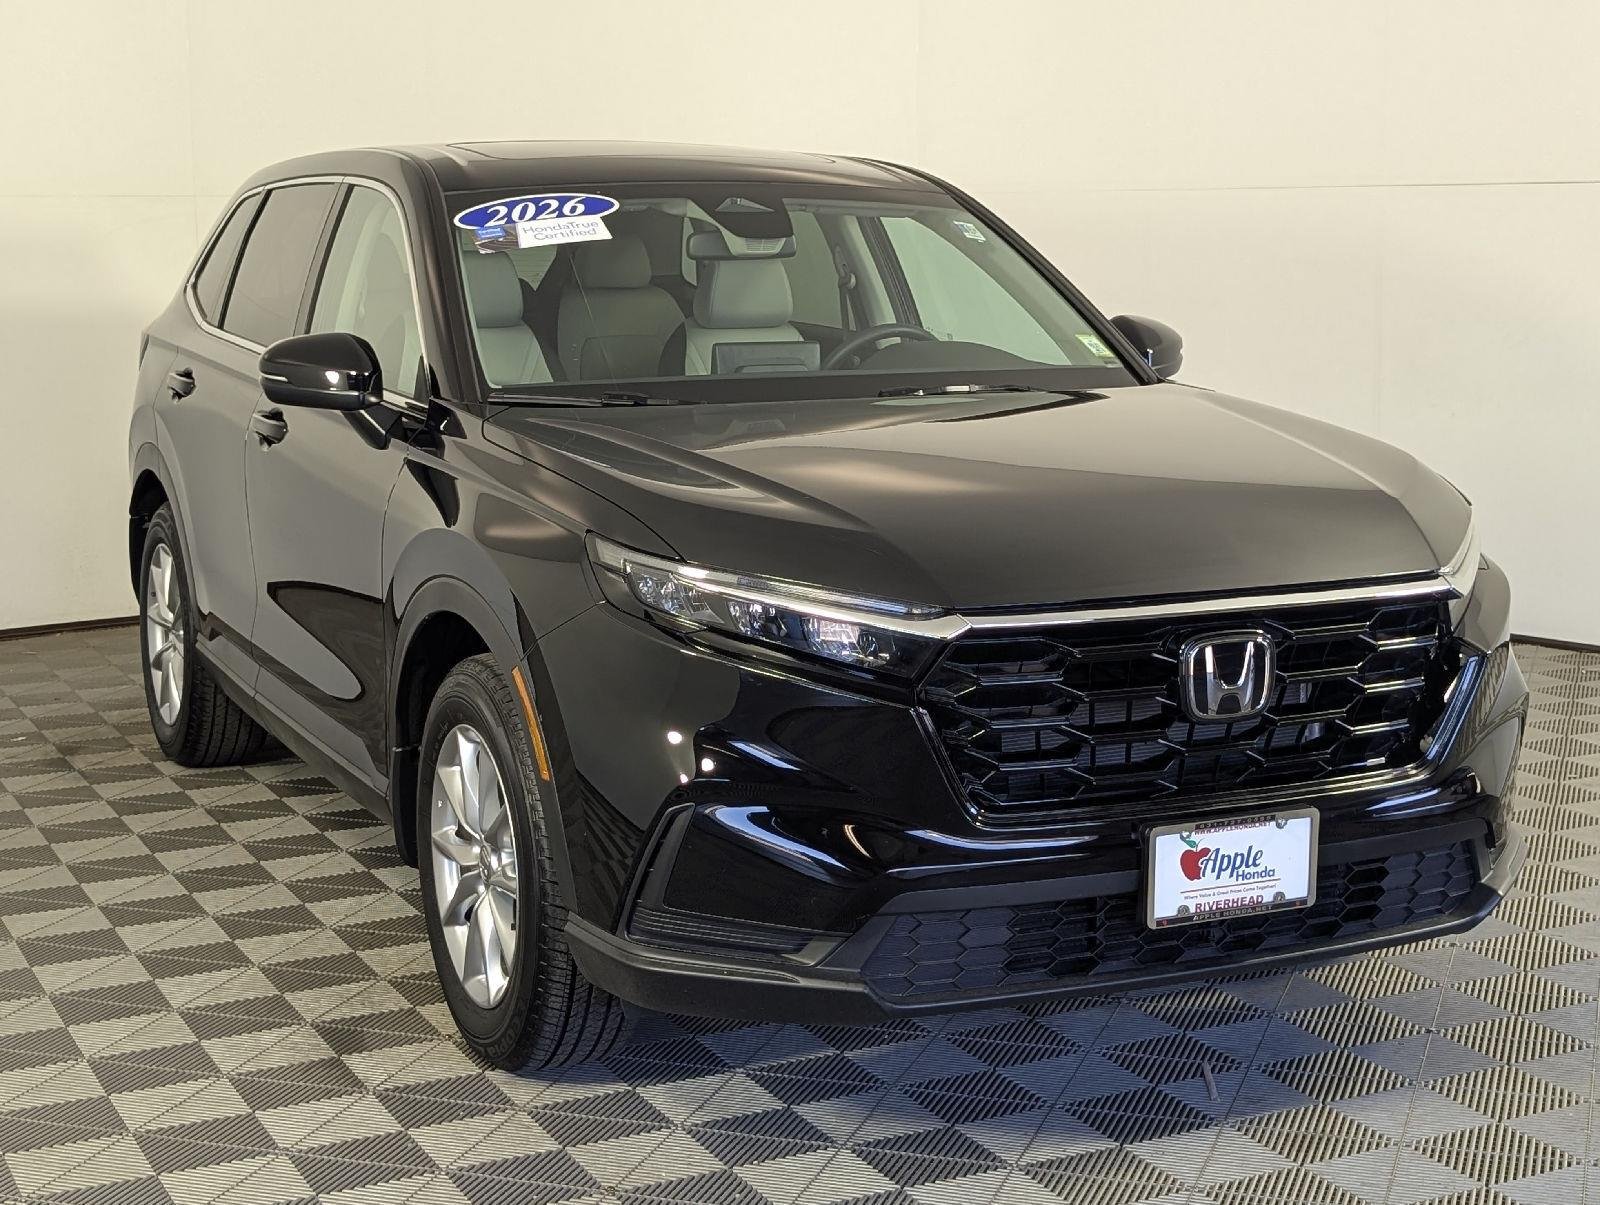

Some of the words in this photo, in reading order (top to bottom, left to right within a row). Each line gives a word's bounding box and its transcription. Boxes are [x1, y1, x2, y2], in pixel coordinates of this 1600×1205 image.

[483, 196, 587, 228] 2026
[522, 221, 599, 235] HondaTrue
[533, 227, 597, 241] Certified
[1199, 845, 1263, 880] Apple
[1235, 866, 1276, 882] Honda
[1194, 894, 1264, 914] RIVERHEAD
[1193, 913, 1221, 921] APPLE
